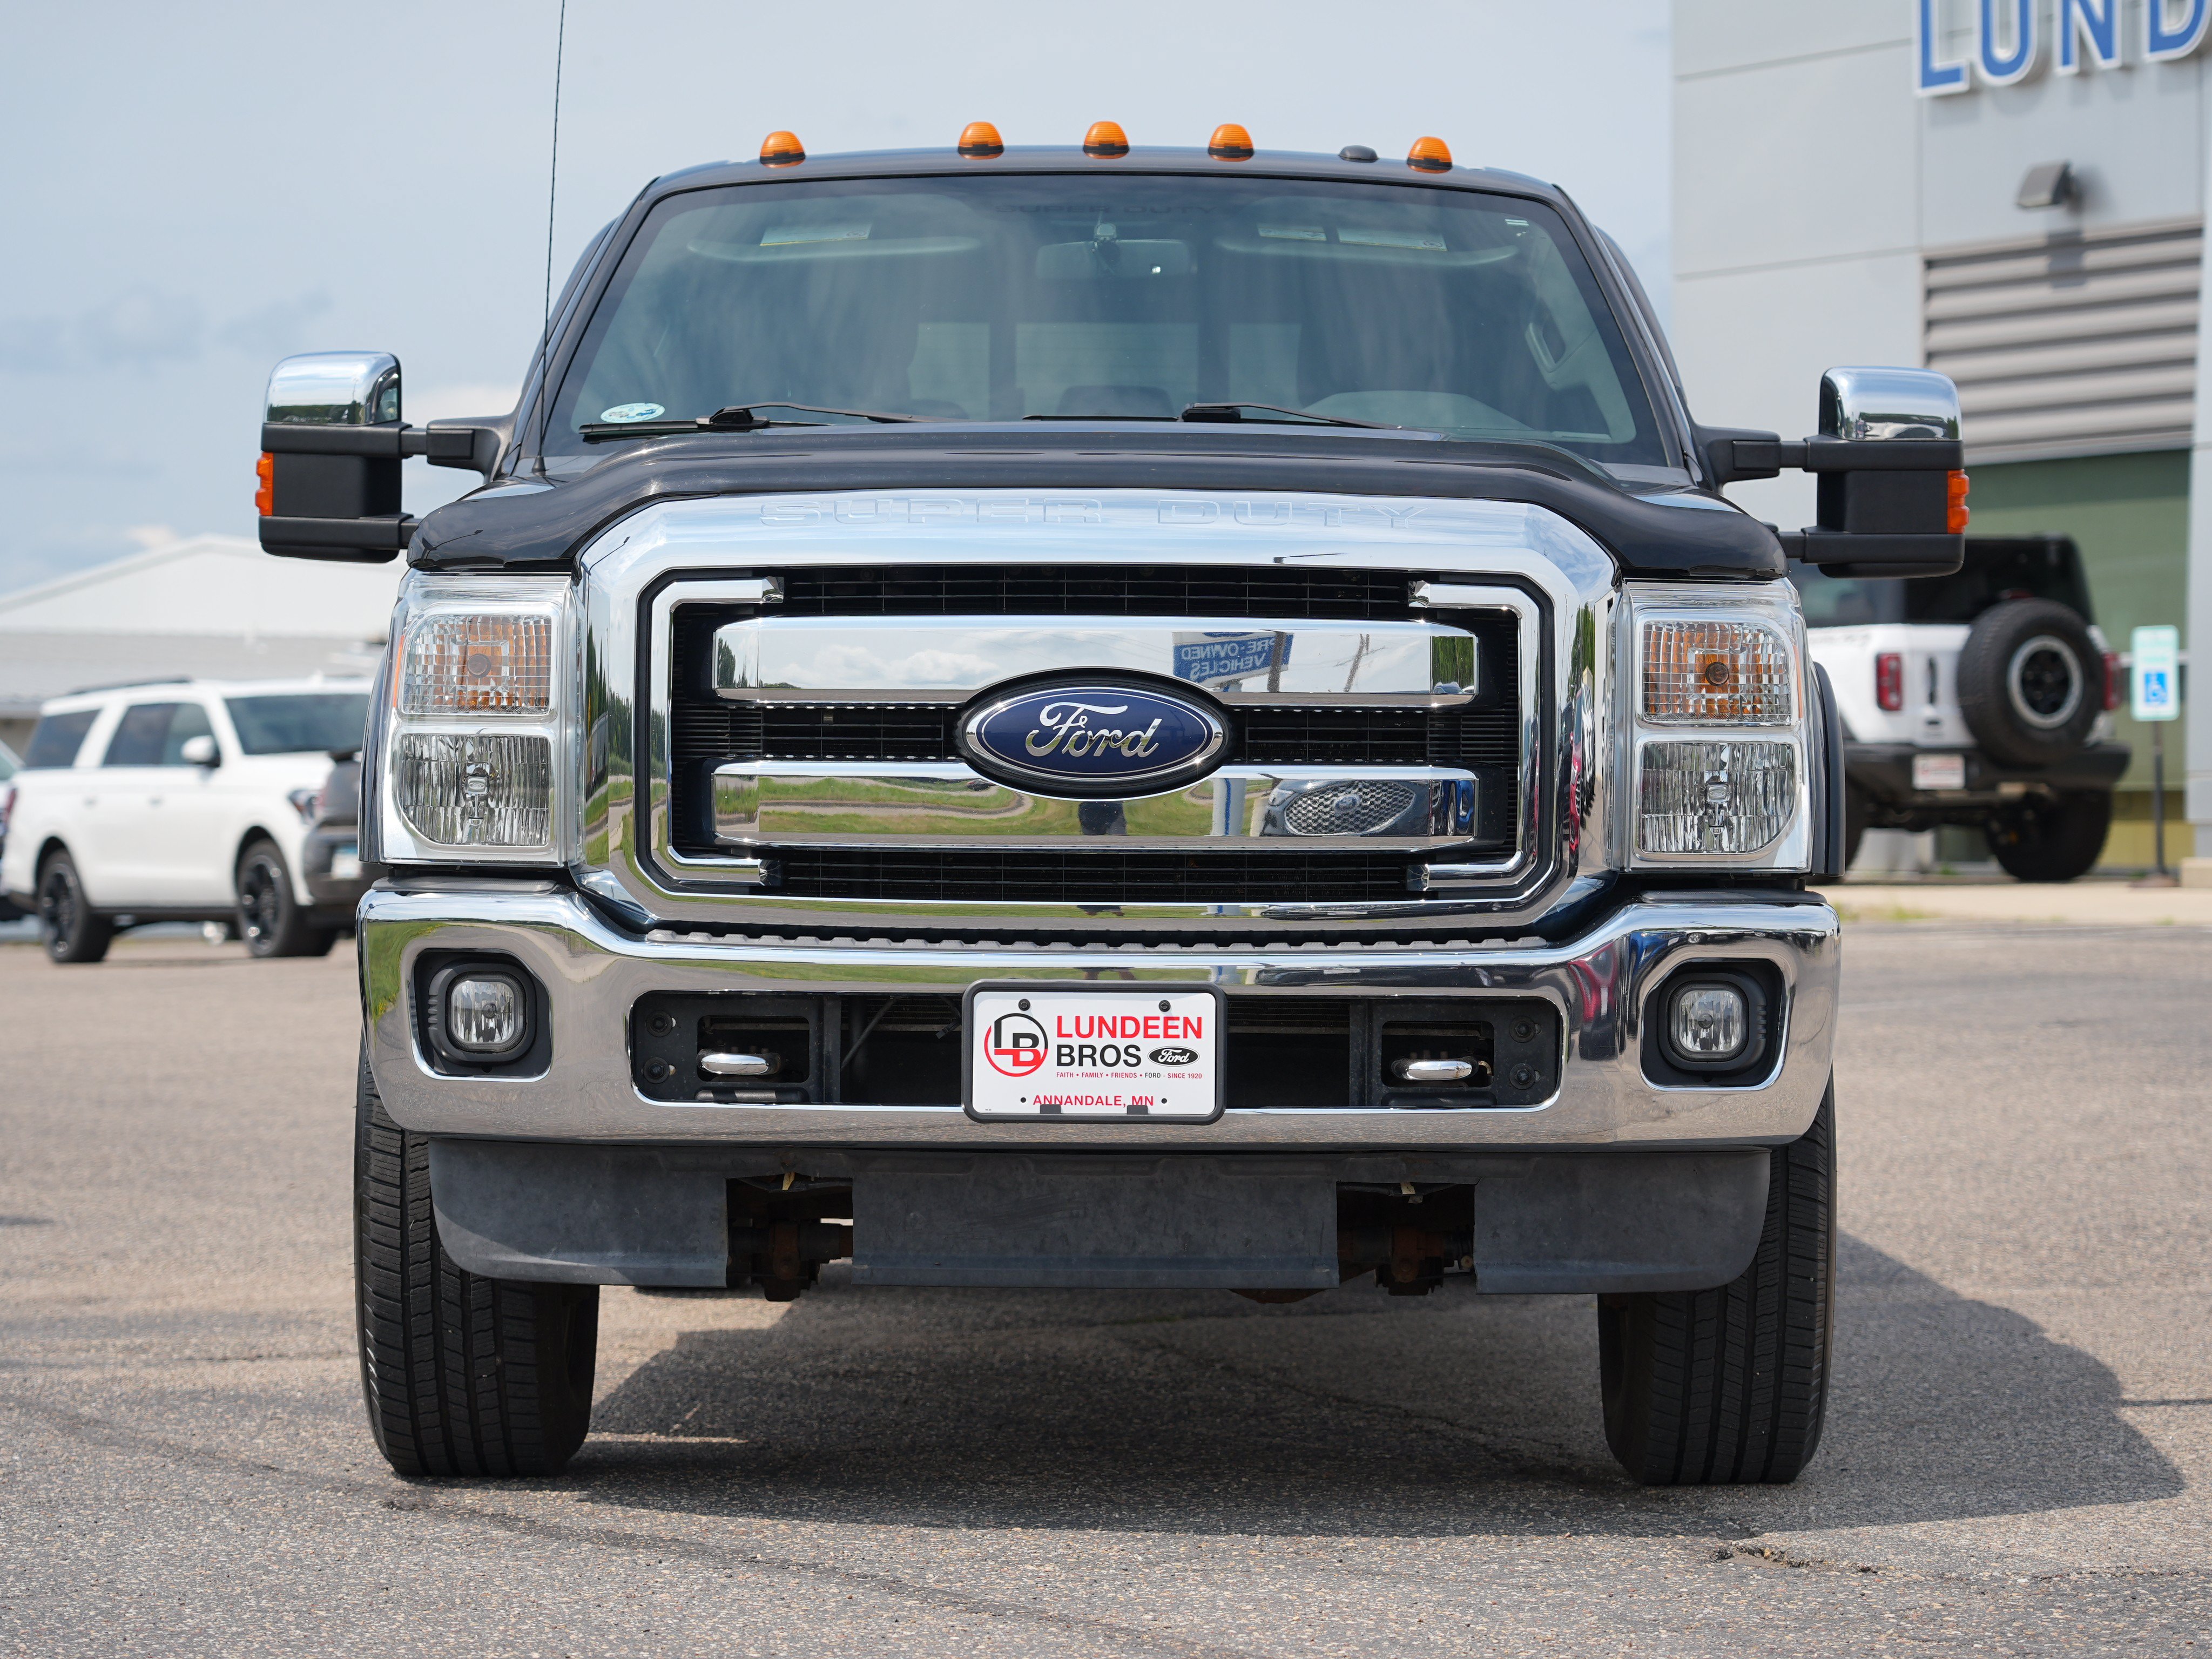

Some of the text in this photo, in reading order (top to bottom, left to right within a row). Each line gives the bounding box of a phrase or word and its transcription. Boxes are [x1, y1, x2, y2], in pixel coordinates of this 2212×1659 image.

[760, 498, 1431, 528] SUPER DUTY
[1026, 702, 1162, 757] Ford
[1057, 1016, 1202, 1038] LUNDEEN
[1056, 1044, 1141, 1067] BROS
[1158, 1049, 1190, 1063] Ford
[1033, 1095, 1154, 1107] ANNANDALE, MN
